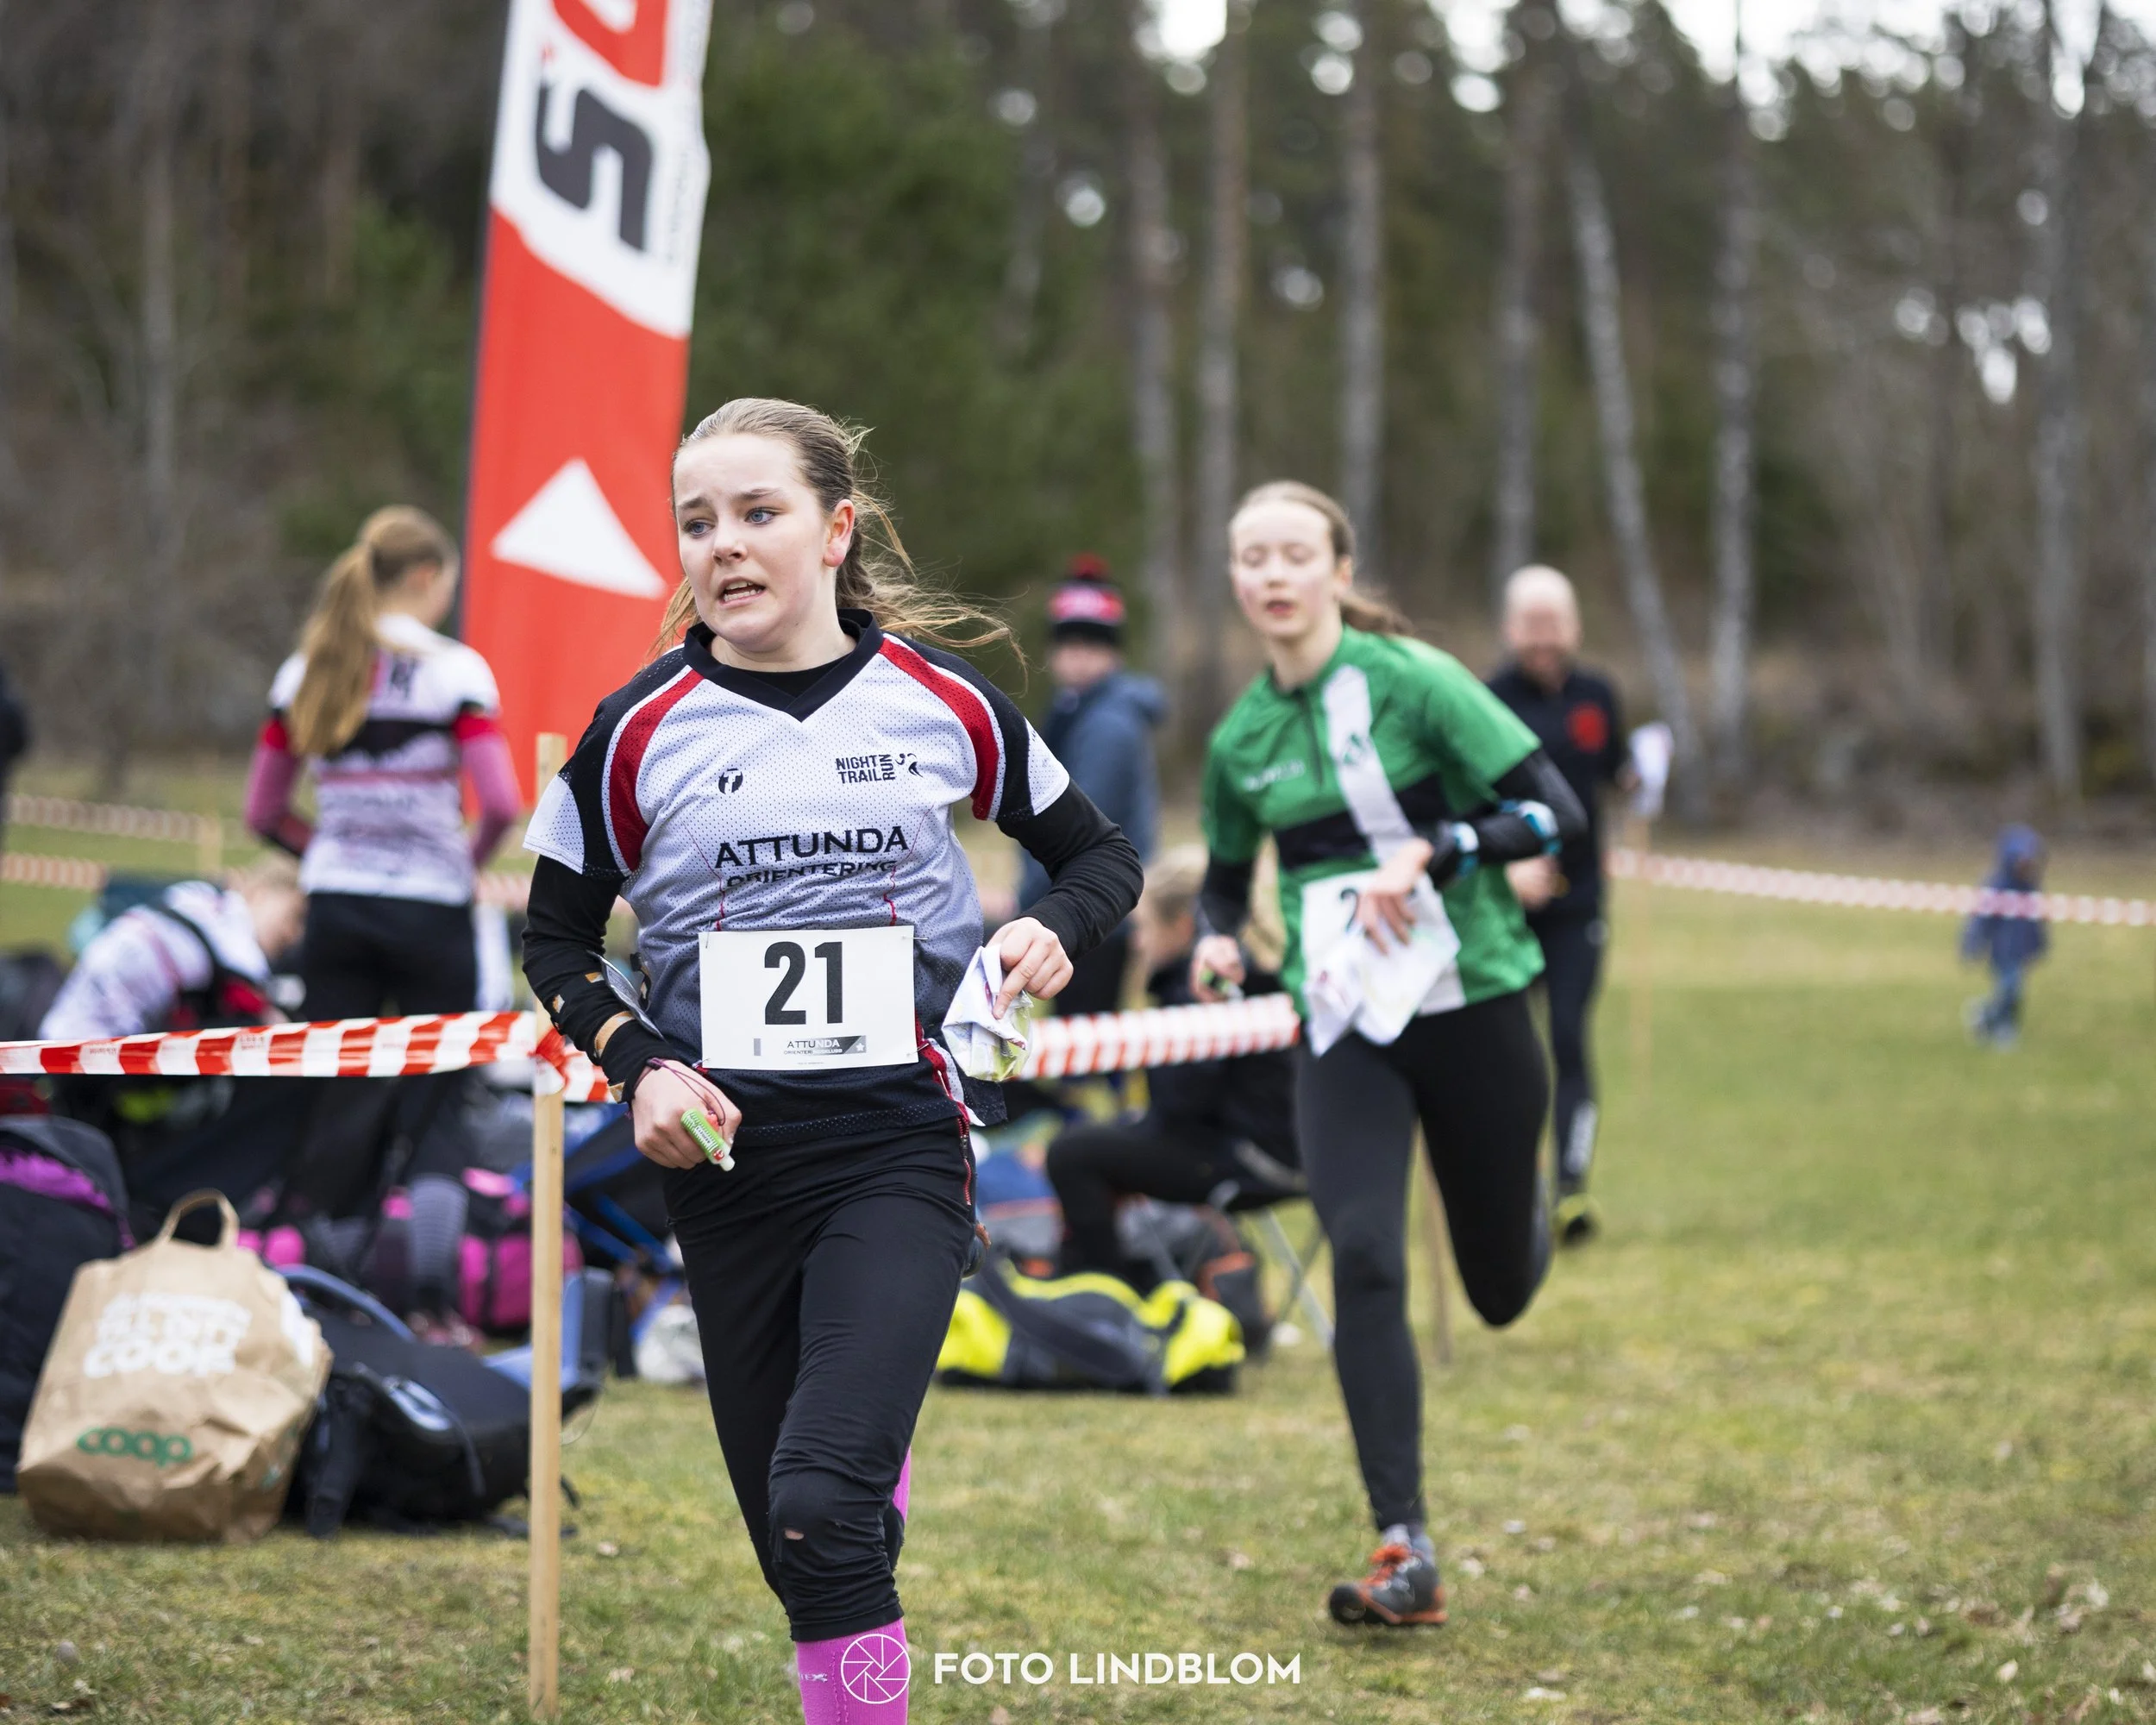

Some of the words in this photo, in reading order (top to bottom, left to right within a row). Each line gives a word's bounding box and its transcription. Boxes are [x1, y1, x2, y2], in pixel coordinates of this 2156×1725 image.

[835, 755, 878, 770] NIGHT
[837, 768, 882, 784] TRAIL
[878, 754, 896, 781] RUN
[714, 825, 910, 869] ATTUNDA
[764, 941, 843, 1026] 21
[787, 1038, 841, 1049] ATTUNDA
[78, 1428, 192, 1466] coop
